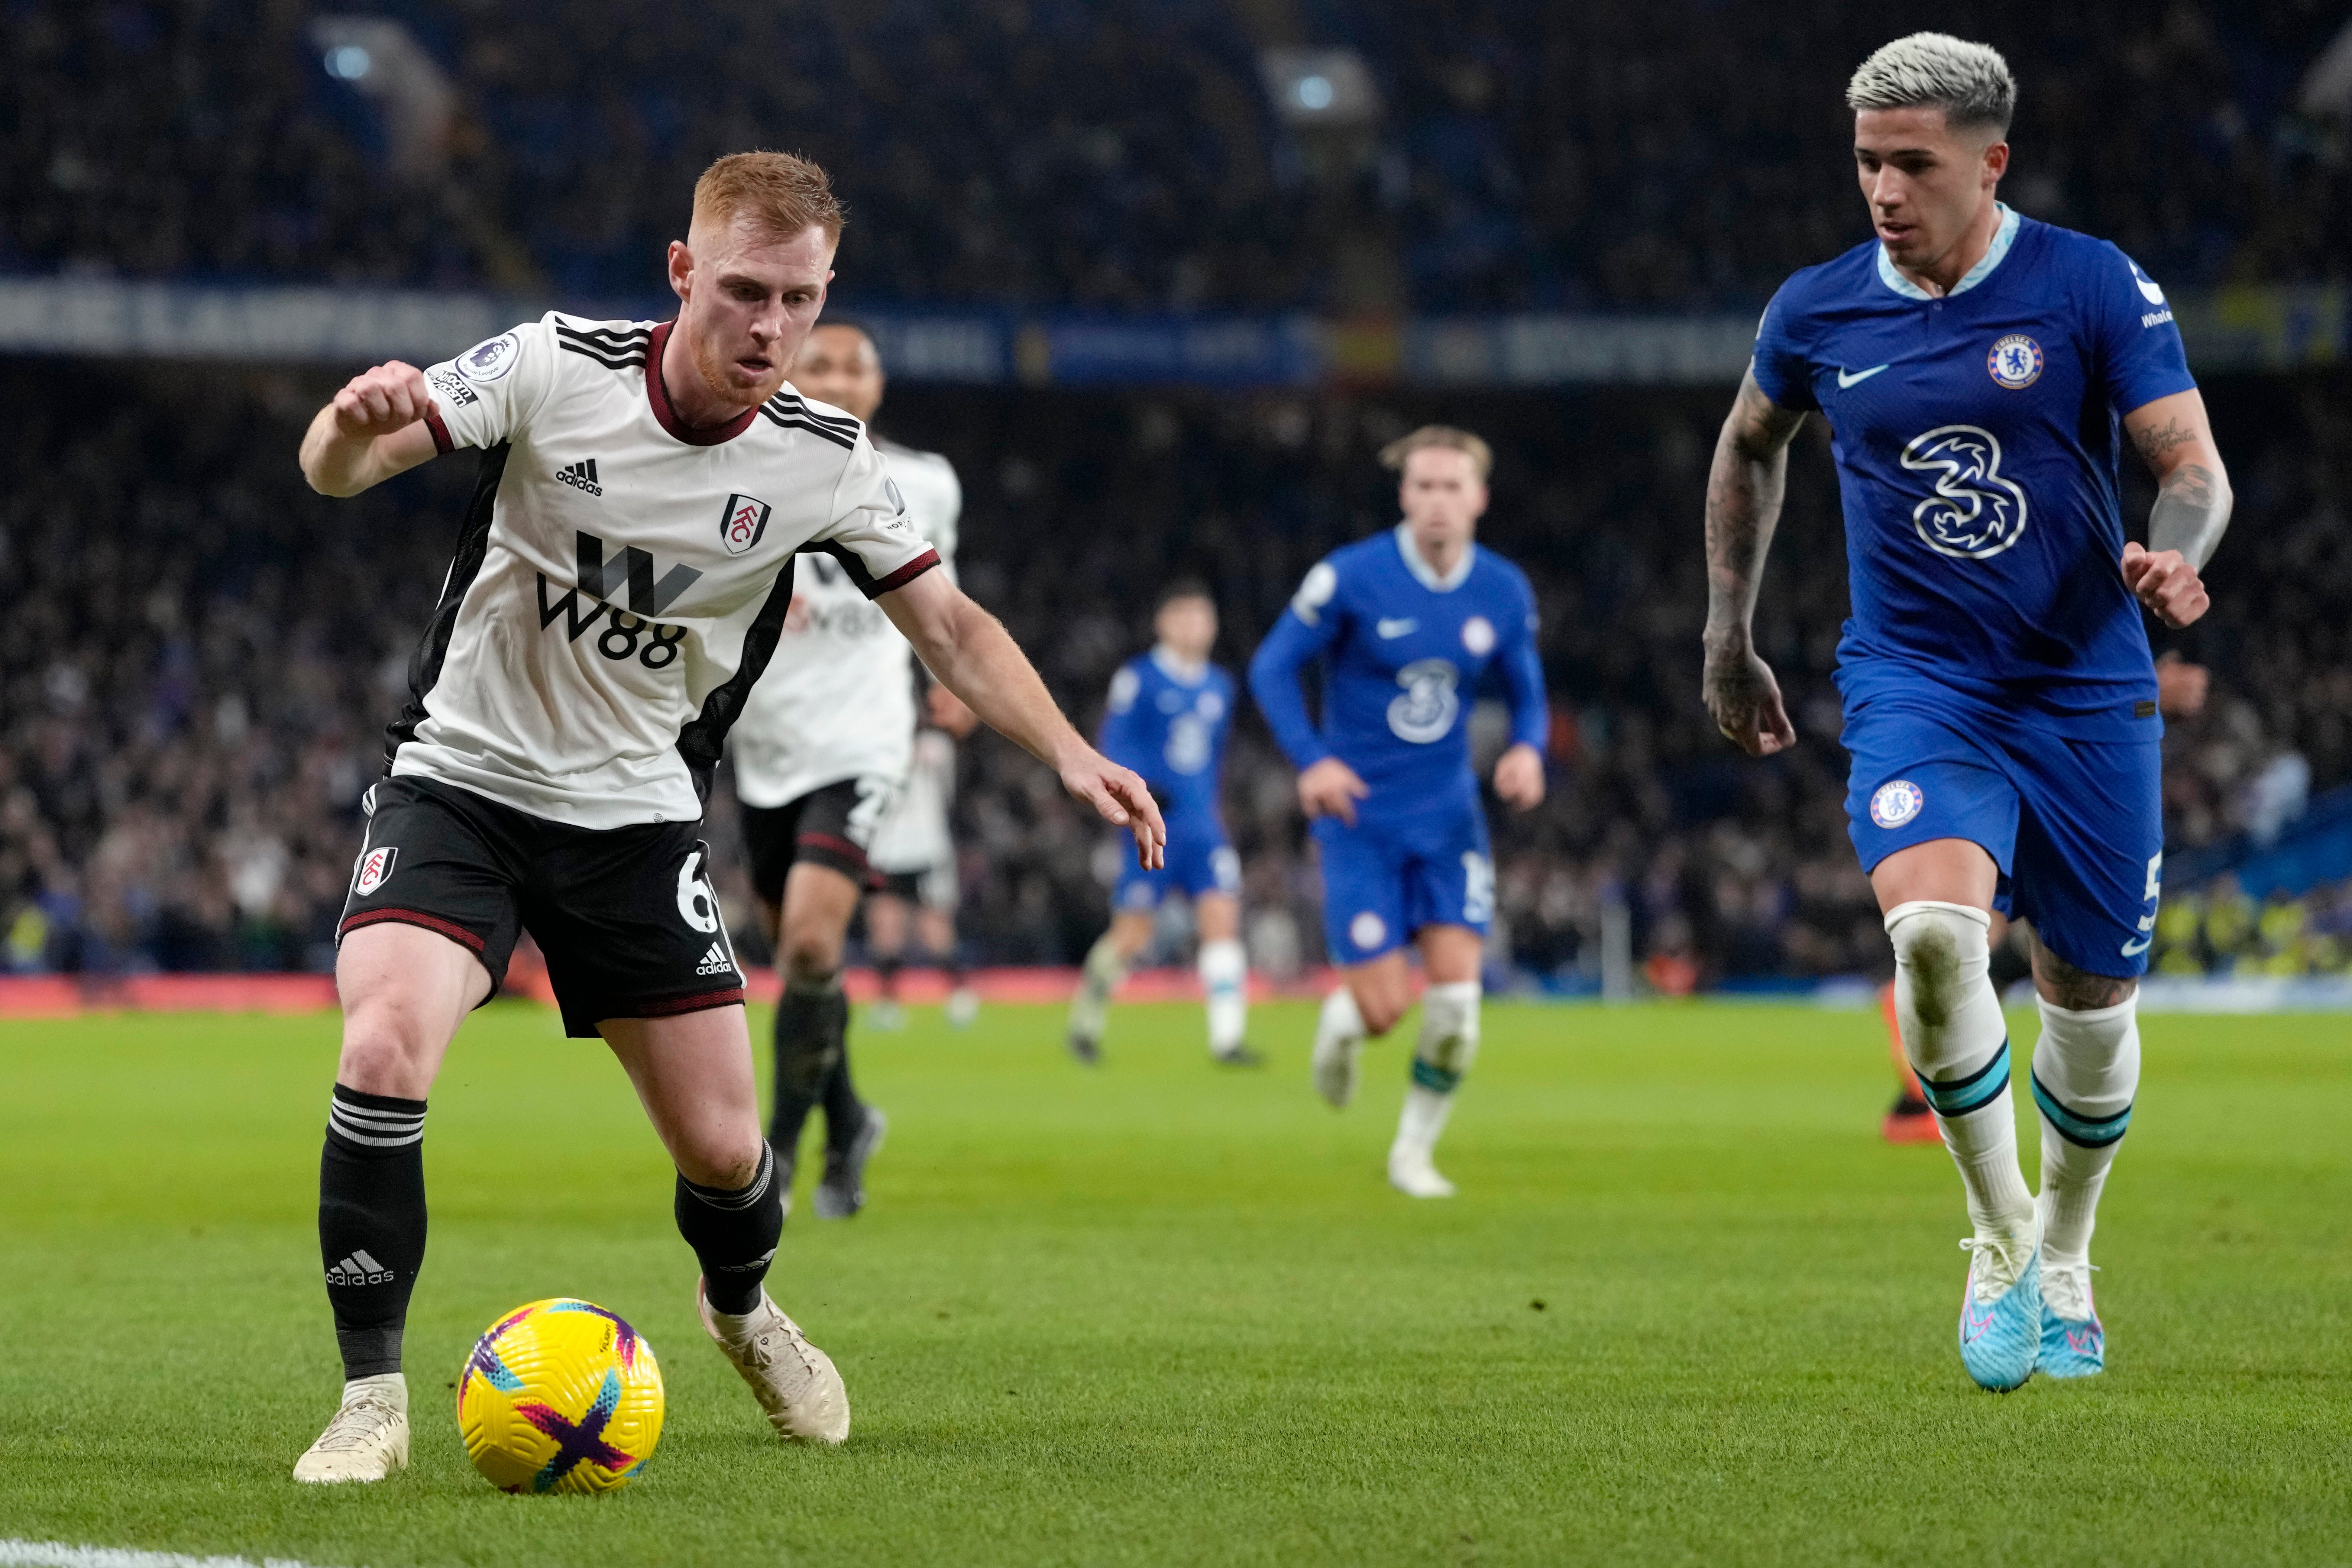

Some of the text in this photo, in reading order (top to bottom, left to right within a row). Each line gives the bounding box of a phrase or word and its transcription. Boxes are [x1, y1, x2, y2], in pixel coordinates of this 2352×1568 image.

[1995, 336, 2030, 352] CHELSEA
[463, 363, 499, 376] Premier League
[556, 471, 602, 497] adidas
[1900, 424, 2027, 559] 3
[731, 505, 758, 543] FFC
[537, 571, 688, 669] W88
[363, 854, 383, 885] FFC
[677, 851, 718, 933] 6
[696, 961, 731, 975] adidas
[326, 1270, 394, 1286] adidas
